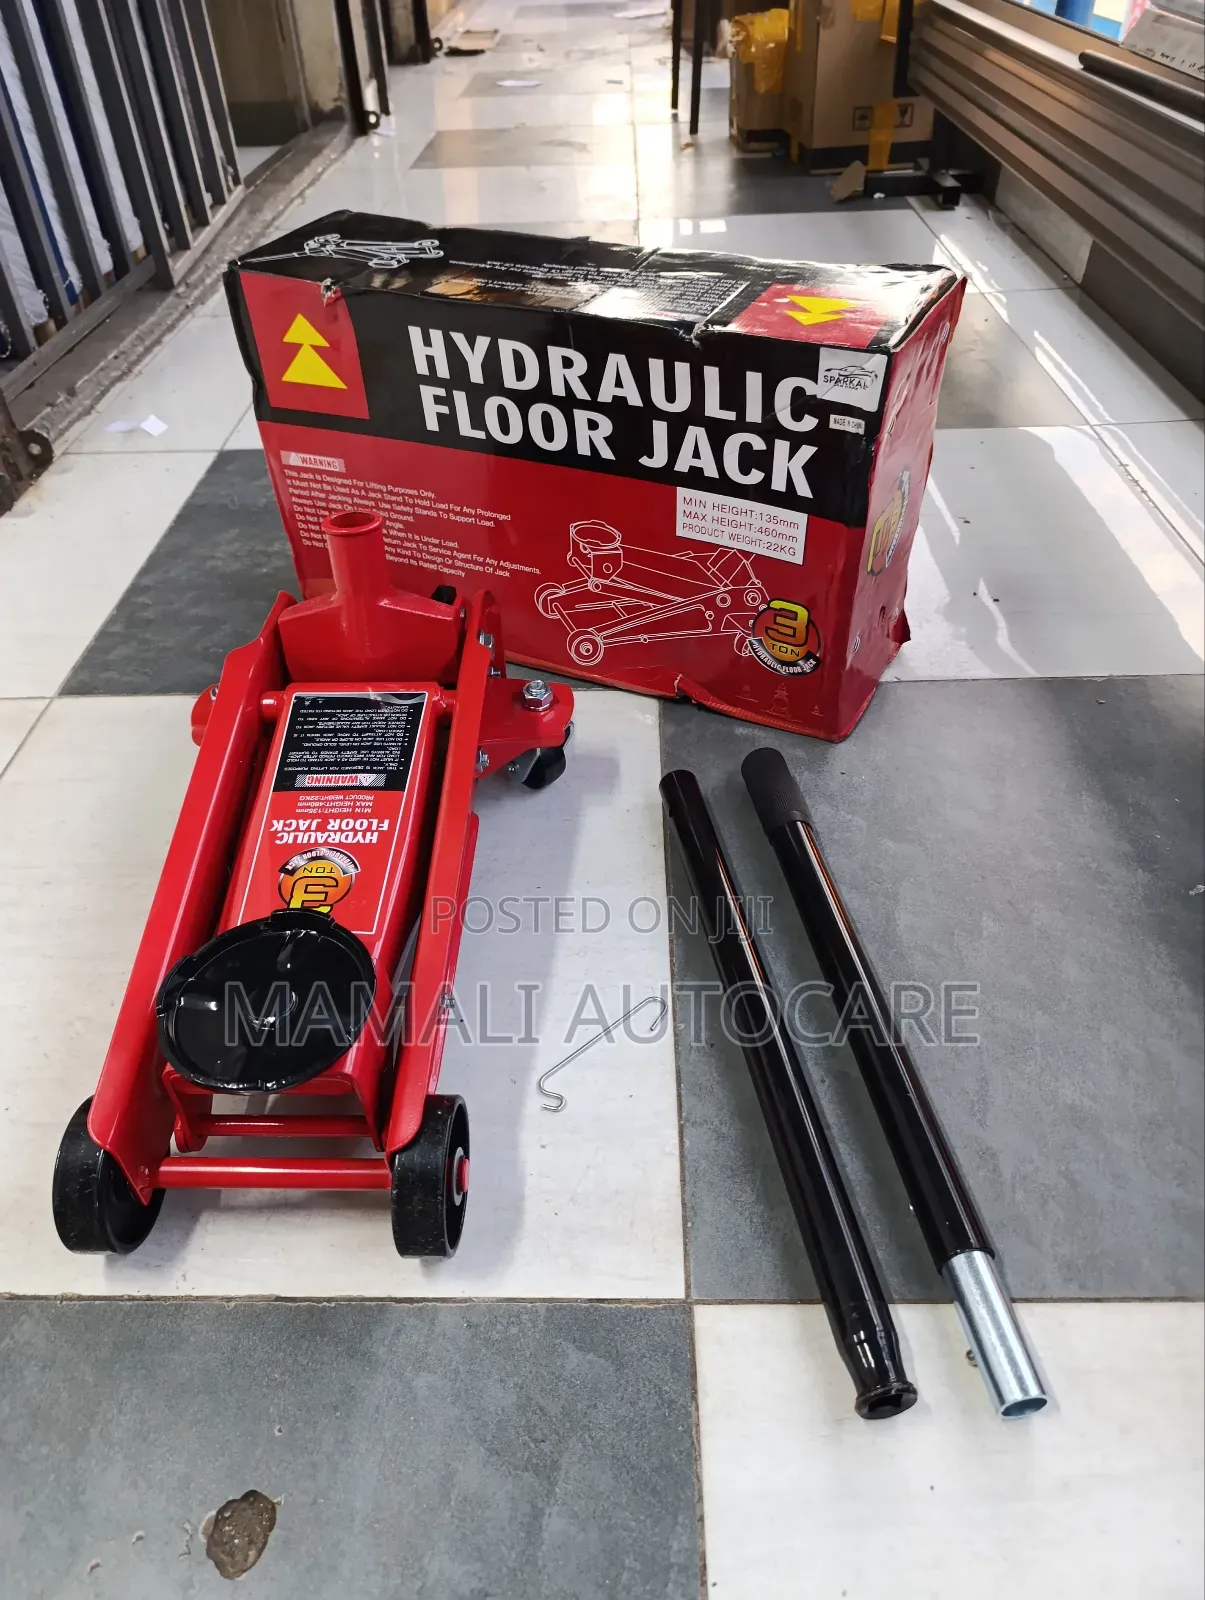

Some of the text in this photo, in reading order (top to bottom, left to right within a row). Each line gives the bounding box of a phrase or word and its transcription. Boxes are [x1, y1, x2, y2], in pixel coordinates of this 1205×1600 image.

[408, 325, 819, 432] HYDRAULIC
[833, 416, 846, 427] MADE
[419, 384, 819, 499] FLOOR JACK
[300, 455, 338, 470] WARNING
[365, 481, 386, 492] Lifting
[387, 484, 418, 496] Purposes
[419, 489, 435, 499] Only.
[333, 485, 349, 494] Used
[367, 491, 381, 499] Jack
[383, 493, 402, 502] Stand
[414, 498, 430, 507] Hold
[431, 501, 448, 510] Load
[449, 504, 460, 512] For
[462, 506, 475, 516] Any
[476, 508, 510, 521] Prolonged
[353, 497, 374, 509] Always
[378, 502, 390, 510] Use
[392, 504, 412, 515] Safety
[414, 508, 437, 517] Stands
[449, 513, 474, 525] Support
[476, 518, 495, 527] Load.
[683, 496, 799, 530] MIN HEIGHT:135mm
[385, 519, 404, 530] Angle.
[389, 511, 414, 521] Ground.
[682, 510, 798, 543] MAX HEIGHT:460mm
[388, 529, 406, 538] When
[420, 535, 439, 544] Under
[441, 538, 459, 548] Load.
[682, 522, 796, 557] PRODUCT WEIGHT:22KG
[384, 545, 395, 554] Any
[396, 547, 411, 556] Kind
[422, 552, 443, 564] Design
[454, 558, 483, 570] Structure
[494, 566, 509, 577] Jack
[385, 553, 408, 565] Beyond
[418, 560, 436, 568] Rated
[438, 563, 464, 576] Capacity
[402, 540, 416, 549] Jack
[428, 545, 451, 555] Service
[453, 550, 471, 560] Agent
[485, 556, 497, 568] Any
[499, 559, 542, 576] Adjustments.
[765, 598, 810, 648] 3
[752, 643, 817, 674] HYDRAULIC FLOOR JACK
[769, 642, 800, 658] TON
[307, 775, 358, 784] WARNING
[269, 819, 390, 832] FLOOR JACK
[275, 832, 379, 844] HYDRAULIC
[284, 855, 301, 871] JACK
[302, 848, 324, 860] FLOOR
[287, 876, 339, 914] 3
